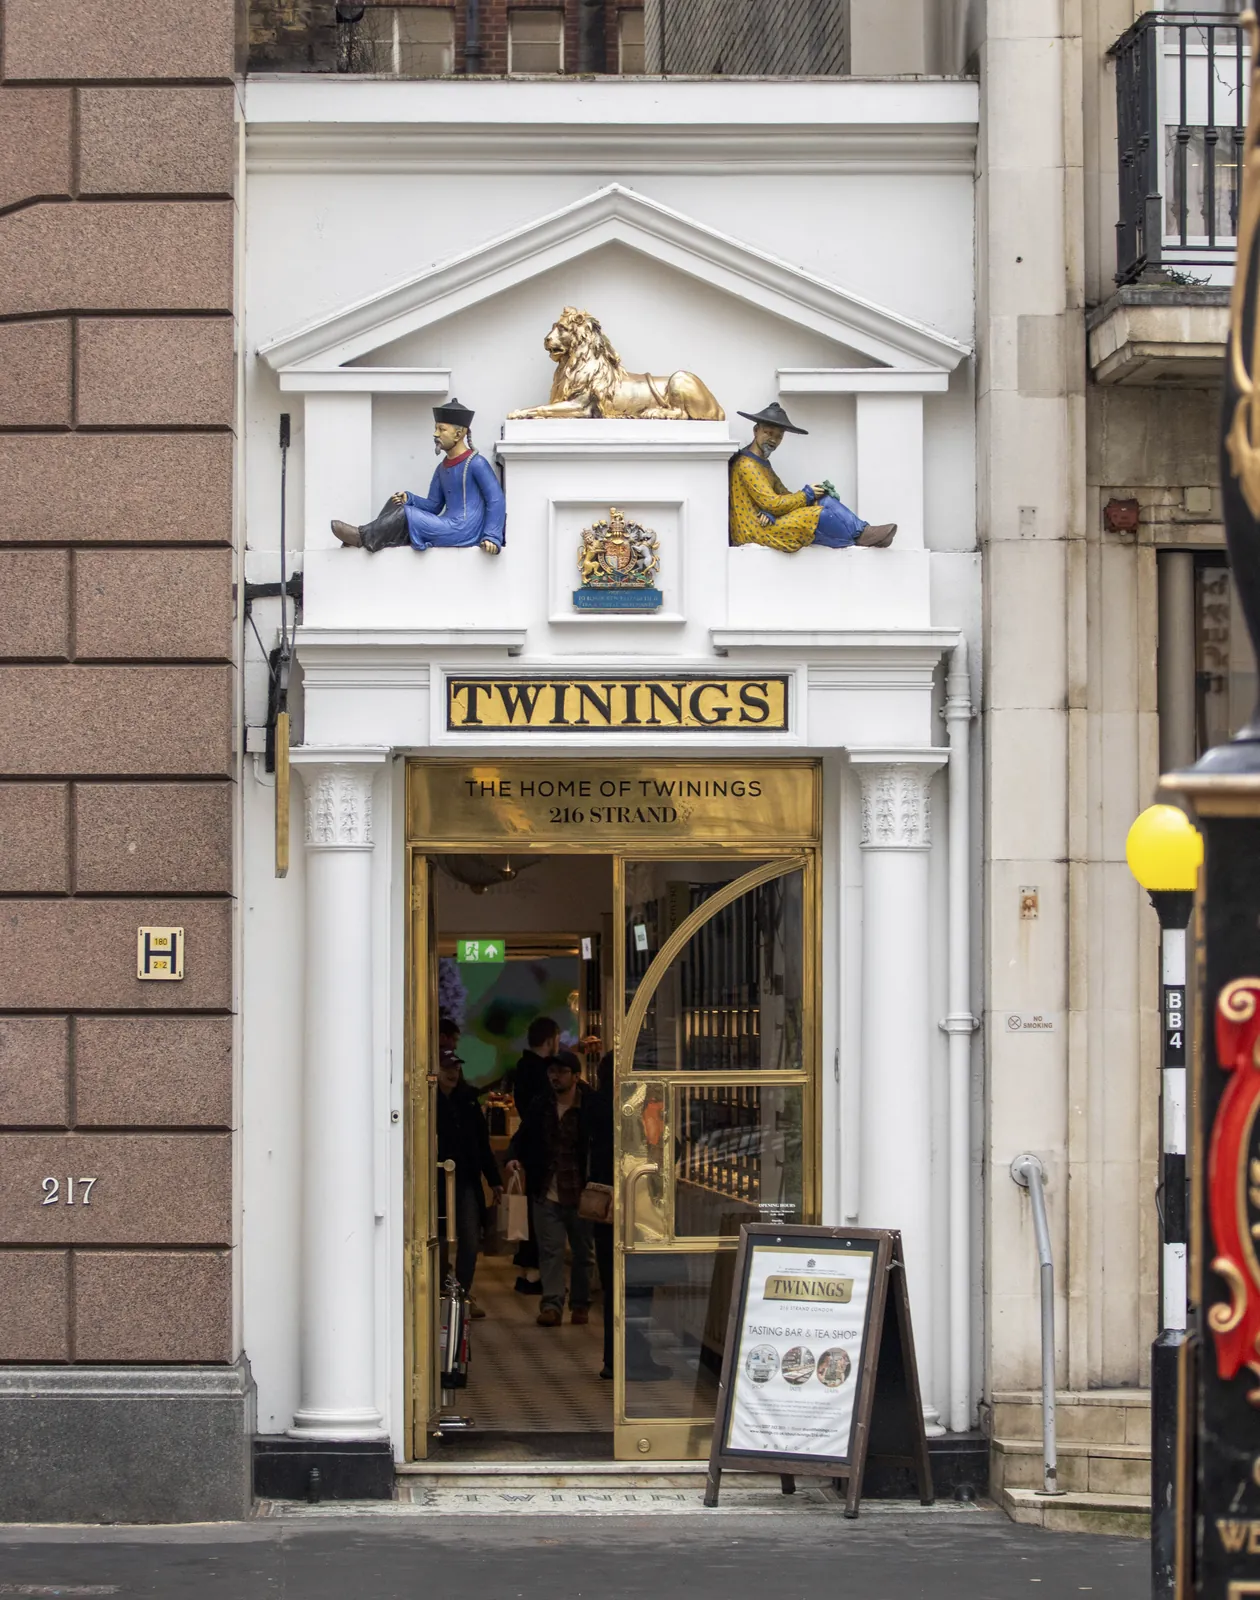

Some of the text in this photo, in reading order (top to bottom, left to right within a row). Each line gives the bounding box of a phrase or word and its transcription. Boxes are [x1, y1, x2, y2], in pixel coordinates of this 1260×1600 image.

[453, 682, 770, 724] TWININGS
[465, 780, 762, 797] THE HOME OF TWININGS
[550, 806, 677, 824] 216 STRAND
[154, 937, 168, 946] 180
[144, 932, 177, 975] H
[41, 1177, 98, 1205] 217
[773, 1279, 845, 1298] TWININGS
[749, 1325, 858, 1340] TASTING BAR & TEA SHOP
